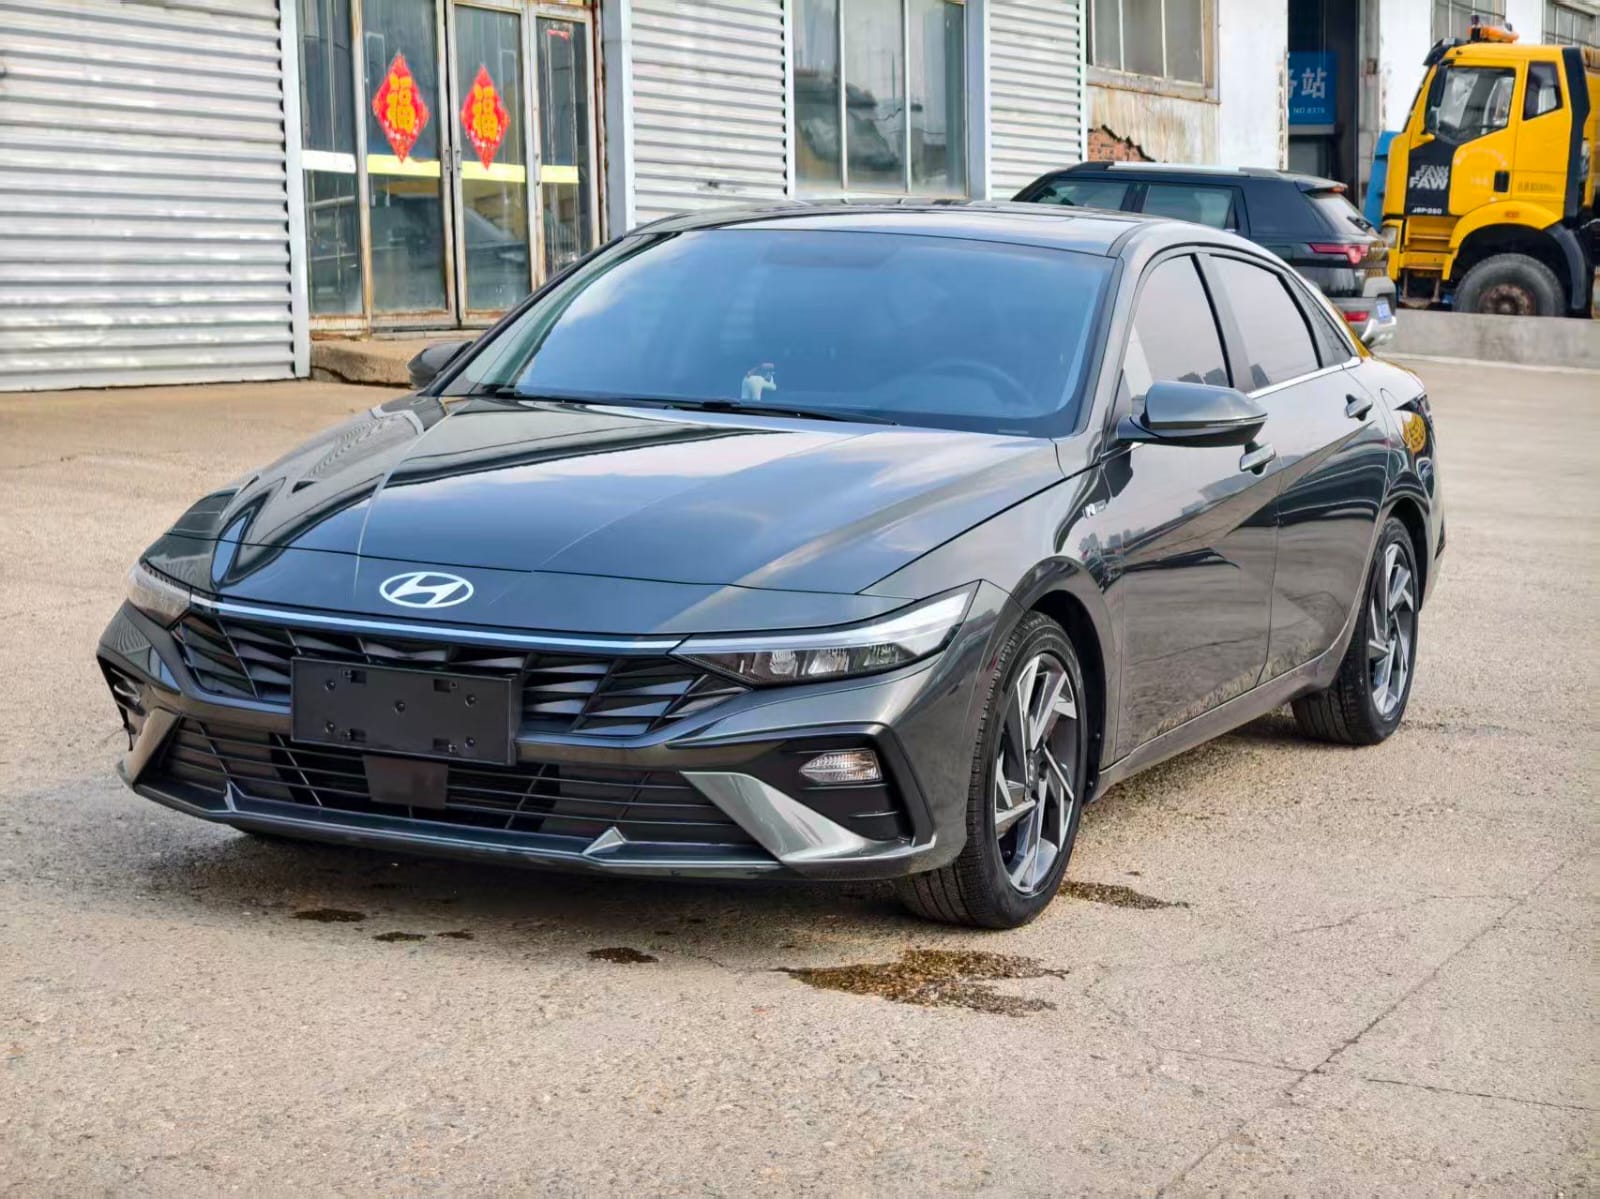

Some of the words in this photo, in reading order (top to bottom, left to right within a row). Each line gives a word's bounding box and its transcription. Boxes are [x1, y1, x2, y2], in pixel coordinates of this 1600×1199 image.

[387, 71, 415, 135] 福
[473, 83, 498, 142] 福
[1409, 176, 1448, 190] FAW
